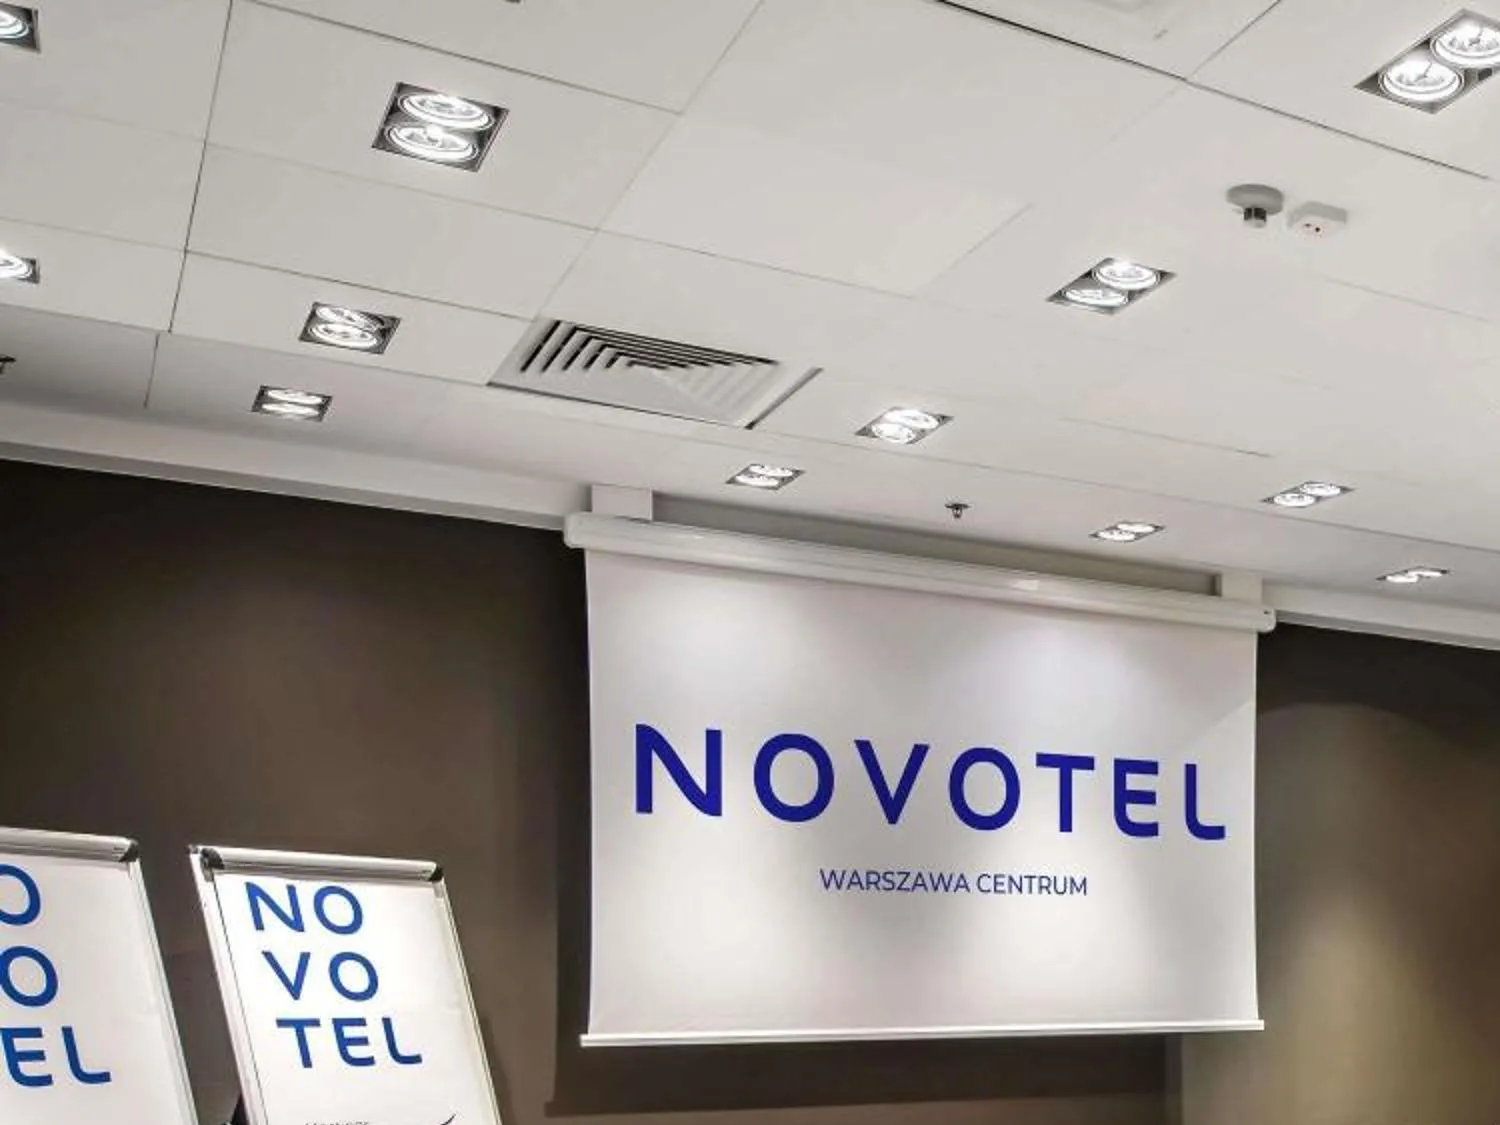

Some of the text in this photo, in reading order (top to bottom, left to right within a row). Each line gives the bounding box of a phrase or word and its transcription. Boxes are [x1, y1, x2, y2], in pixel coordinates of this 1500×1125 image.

[635, 723, 1227, 842] NOVOTEL
[819, 868, 1088, 896] WARSZAWA CENTRUM
[245, 881, 364, 936] NO
[262, 951, 379, 1002] VO
[276, 1017, 422, 1069] TEL
